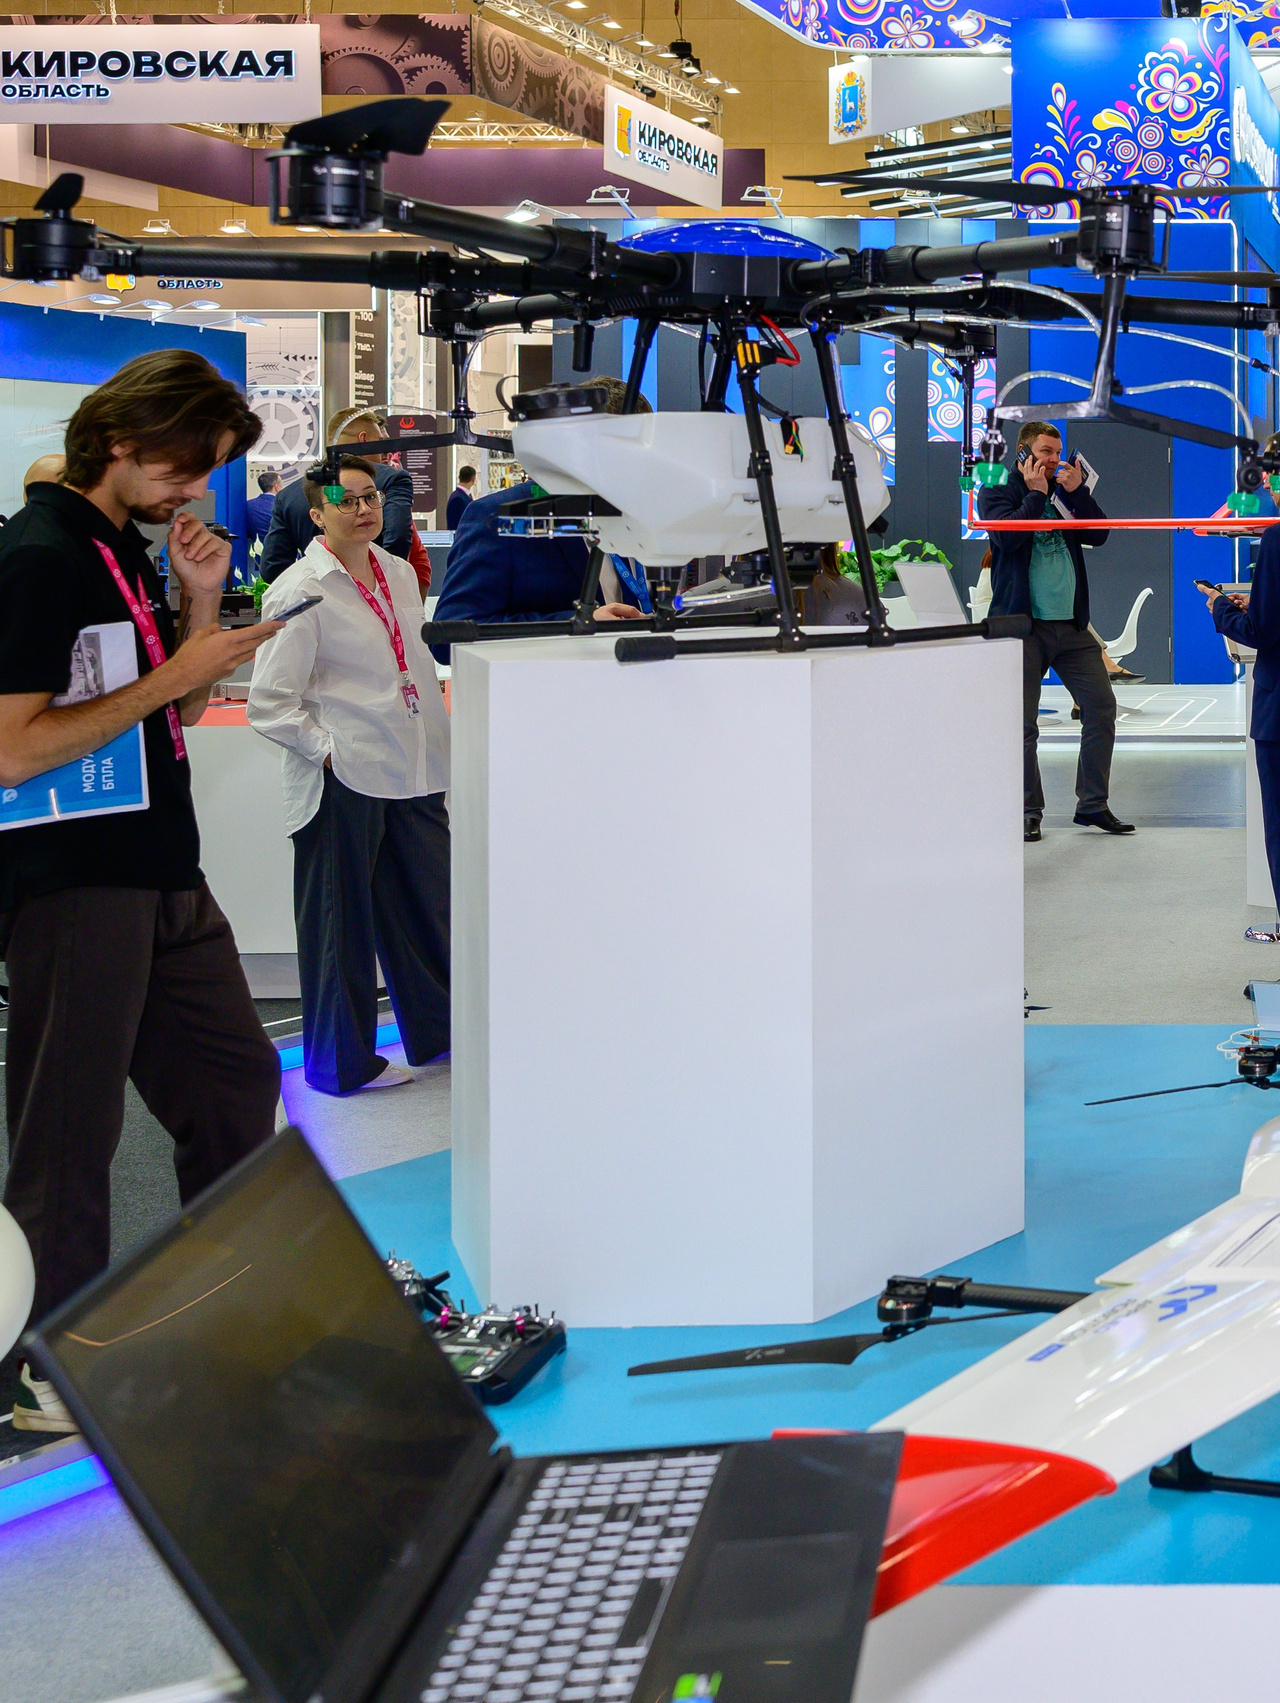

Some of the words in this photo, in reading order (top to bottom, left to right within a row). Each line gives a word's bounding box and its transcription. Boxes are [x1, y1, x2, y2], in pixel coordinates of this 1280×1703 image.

[2, 49, 295, 79] КИРОВСКАЯ
[1, 83, 110, 99] ОБЛАСТЬ
[637, 149, 670, 171] ОБЛАСТЬ
[638, 120, 718, 175] КИРОВСКАЯ
[157, 279, 224, 290] ОБЛАСТЬ
[82, 754, 97, 793] МОДУ
[101, 756, 115, 791] БПЛА
